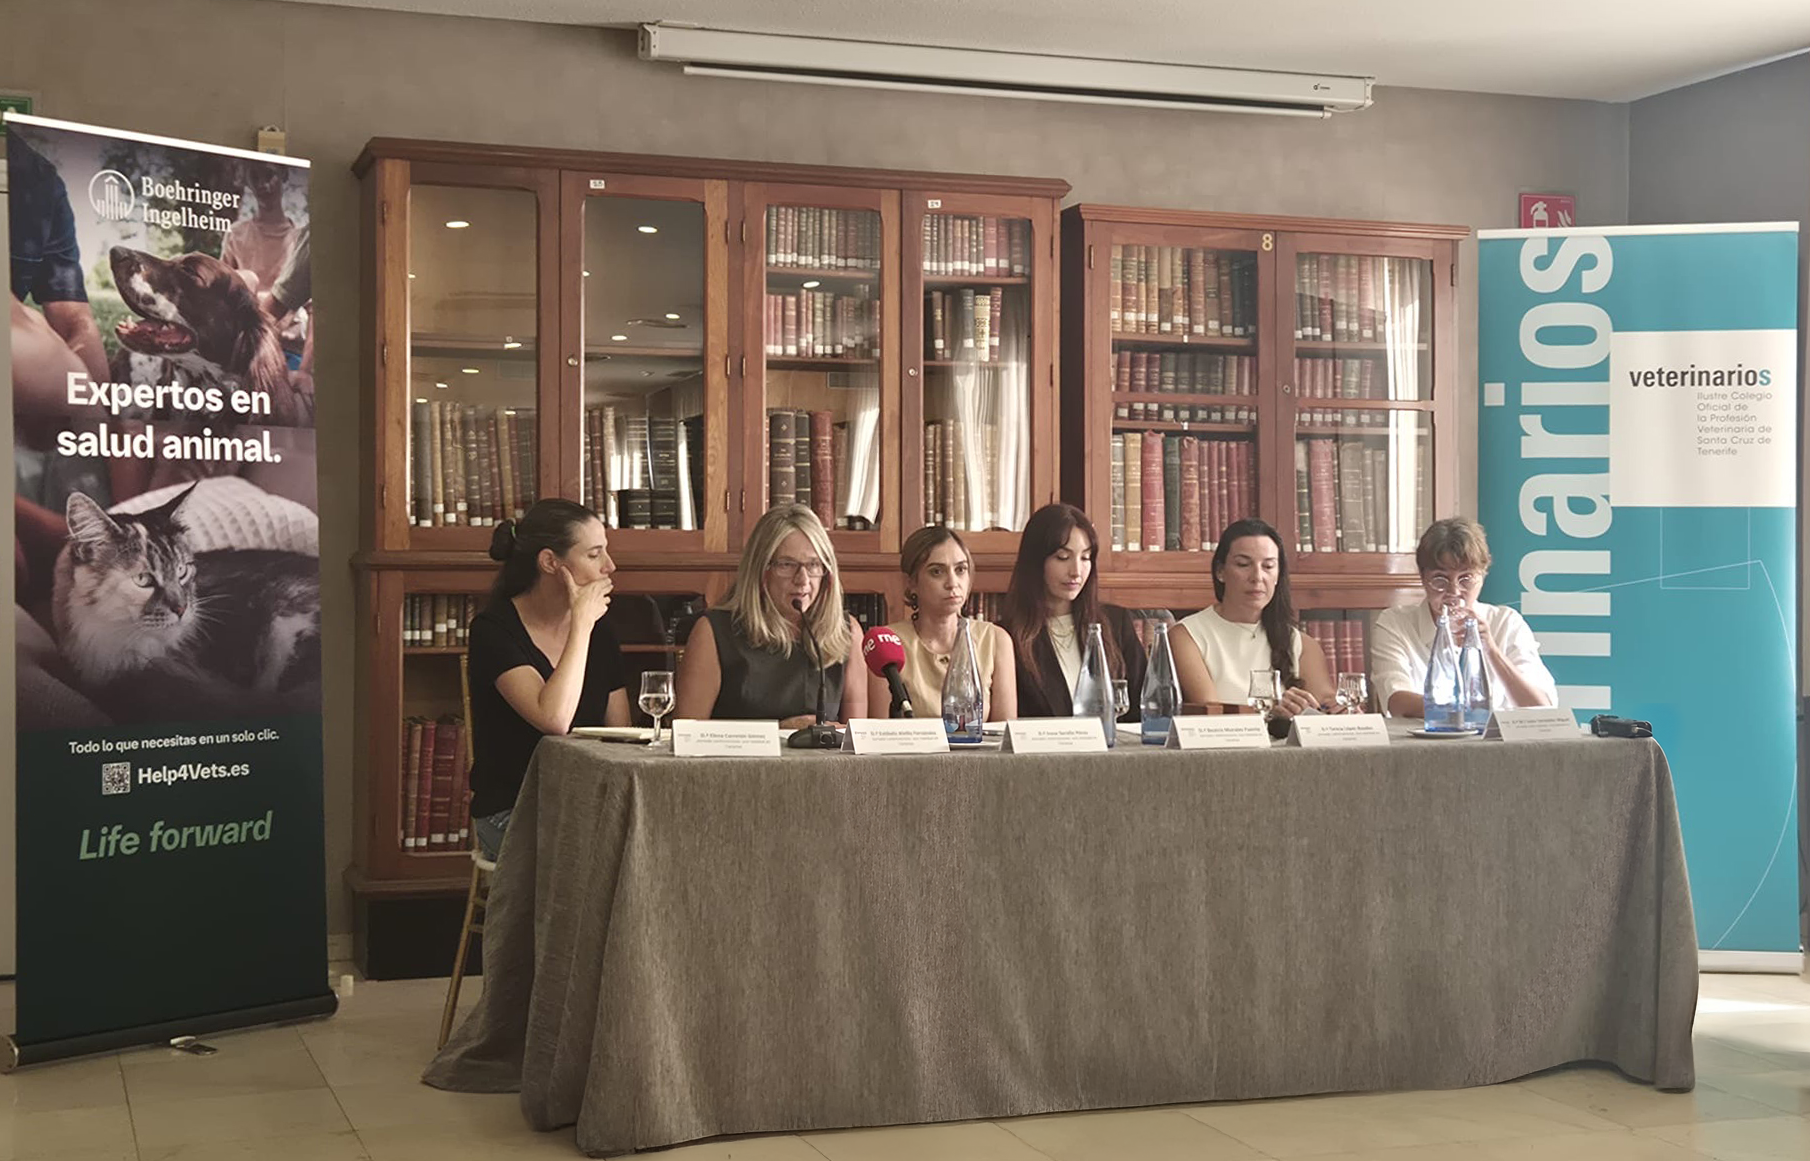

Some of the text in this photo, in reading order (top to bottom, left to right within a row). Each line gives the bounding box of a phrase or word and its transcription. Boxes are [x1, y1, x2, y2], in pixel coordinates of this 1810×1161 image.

[141, 176, 241, 209] Boehringer
[142, 204, 232, 233] Ingelheim
[1262, 233, 1273, 251] 8
[1629, 364, 1772, 388] veterinarios
[67, 372, 271, 415] Expertos en
[1697, 391, 1773, 403] Ilustre Colegio
[1697, 402, 1748, 411] Oficial de
[1697, 413, 1757, 422] la Profesión
[1697, 424, 1772, 434] Veterinaria de
[1697, 435, 1772, 445] Santa Cruz de
[57, 423, 282, 463] salud animal.
[1697, 446, 1738, 456] Tenerife
[69, 728, 280, 754] Todo lo que necesitas en un solo clic.
[138, 761, 250, 786] Help4Vets.es
[79, 810, 273, 860] Life forward
